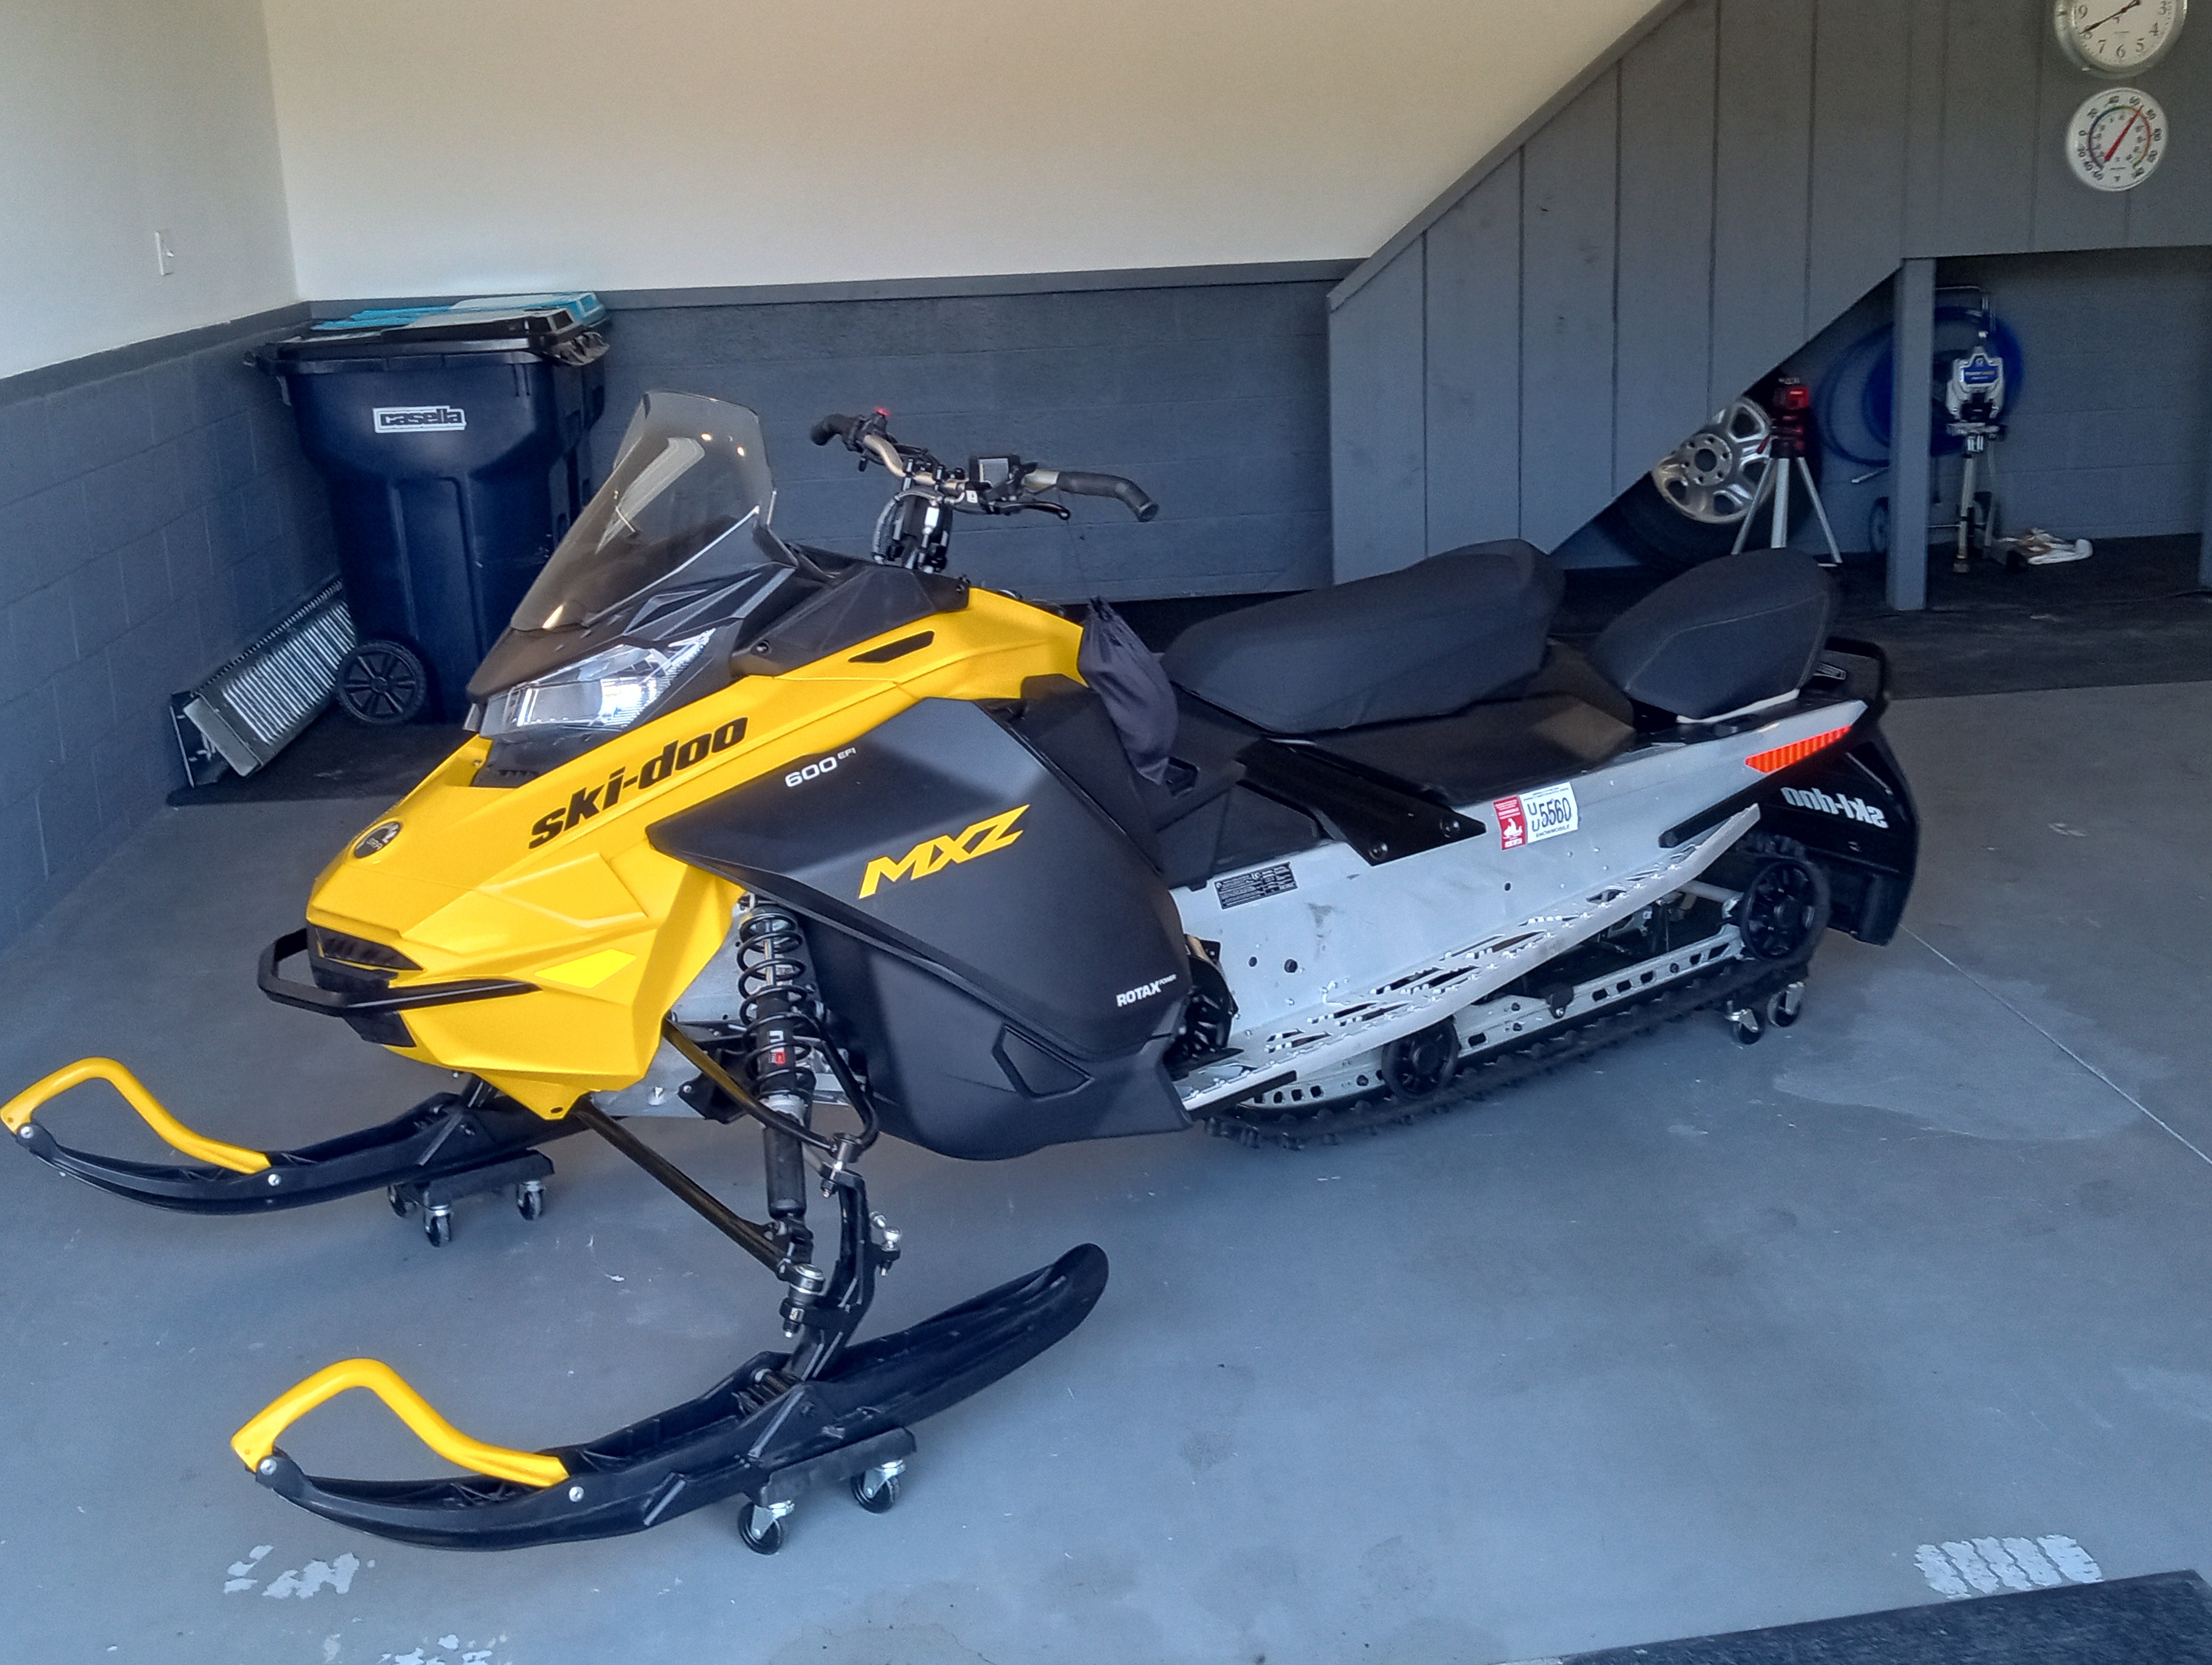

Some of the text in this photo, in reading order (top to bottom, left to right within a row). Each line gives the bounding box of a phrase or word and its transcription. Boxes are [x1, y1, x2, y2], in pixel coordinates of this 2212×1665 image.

[2078, 5, 2088, 19] 9
[2159, 1, 2167, 15] 3
[2149, 22, 2159, 36] 4
[2098, 39, 2106, 54] 7
[2116, 44, 2126, 58] 6
[2136, 38, 2144, 53] 5
[381, 408, 462, 426] casella
[785, 747, 857, 787] 600 EFI
[528, 717, 748, 850] ski-doo
[1538, 797, 1572, 828] 5560
[858, 804, 1030, 899] MXZ
[1116, 980, 1162, 1007] ROTAX
